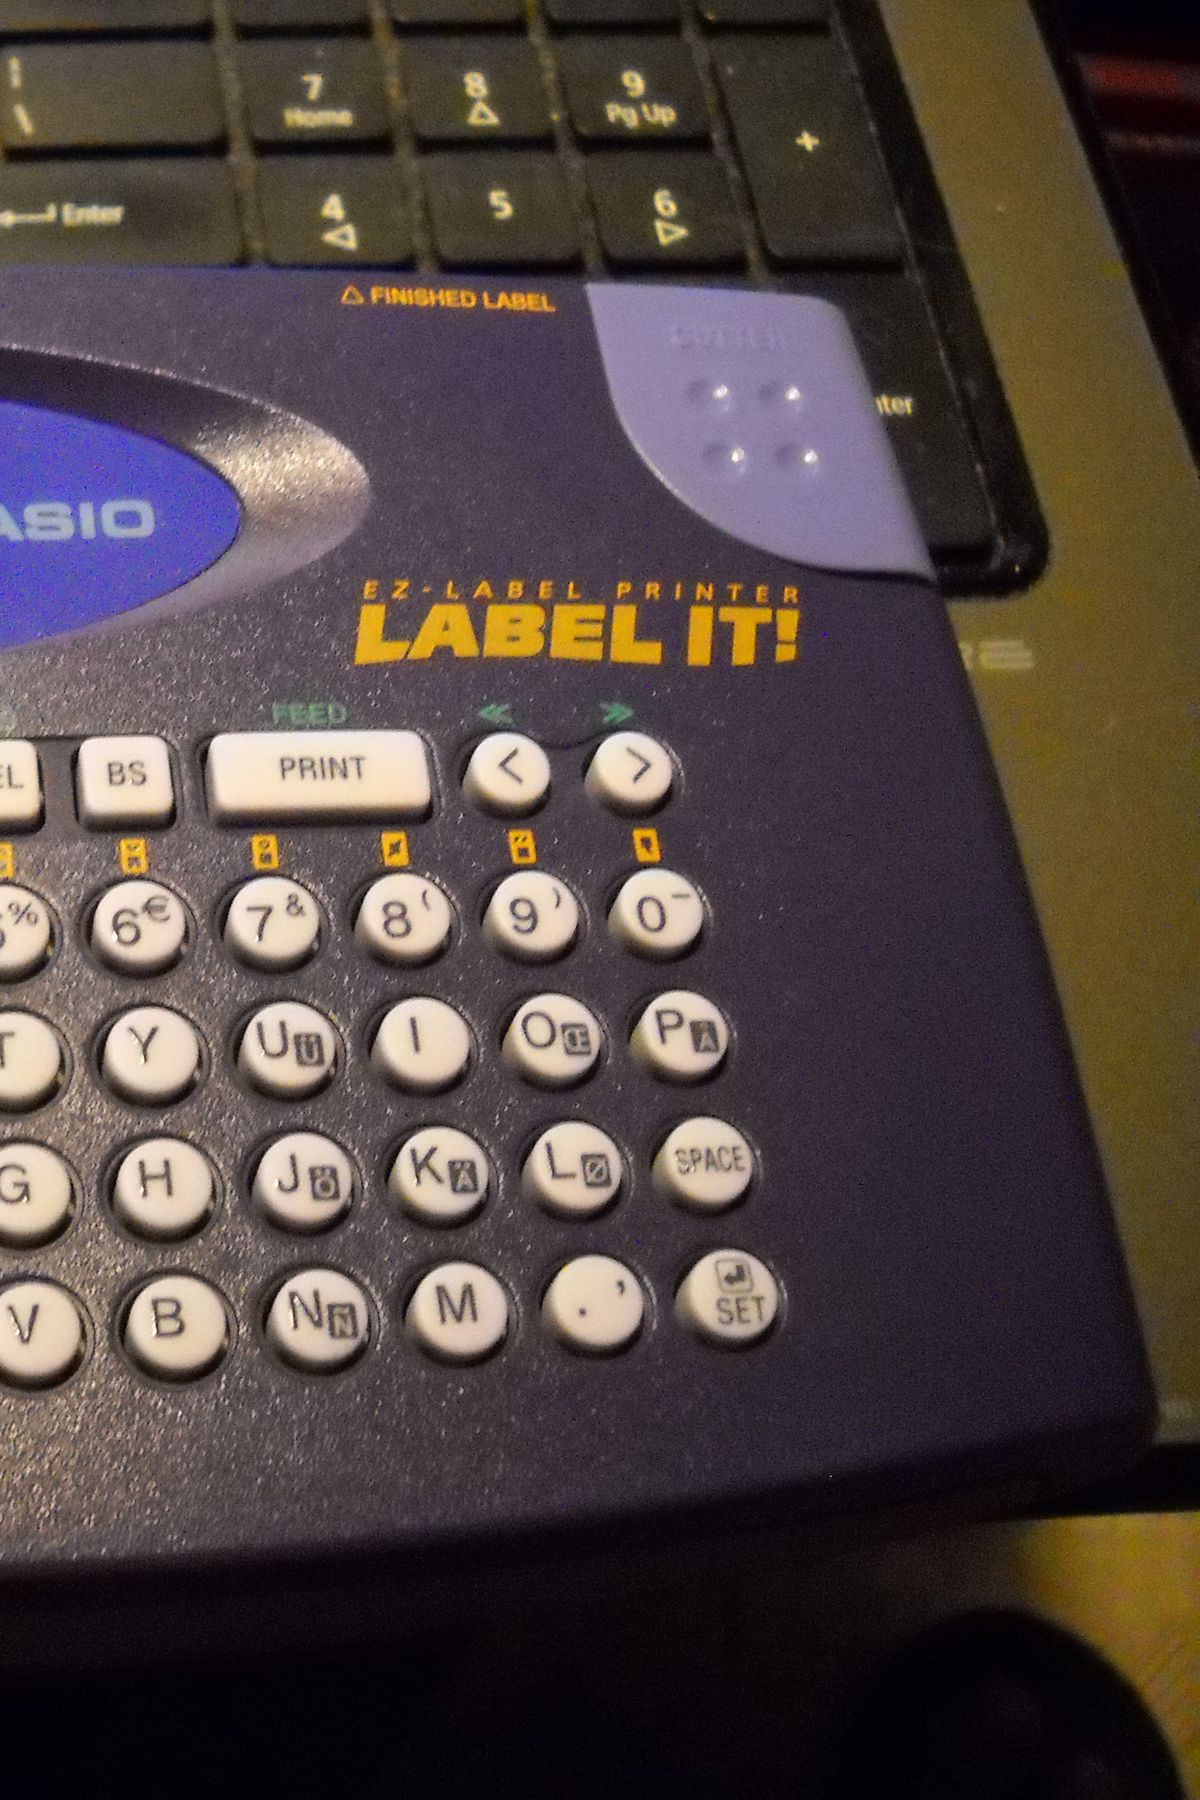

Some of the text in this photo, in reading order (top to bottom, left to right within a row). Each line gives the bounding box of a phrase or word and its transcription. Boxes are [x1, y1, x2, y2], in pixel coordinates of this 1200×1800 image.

[302, 73, 323, 101] 7
[463, 71, 488, 98] 8
[621, 70, 645, 98] 9
[606, 102, 677, 129] Pg Up
[62, 202, 124, 227] Enter
[321, 193, 346, 222] 4
[488, 189, 514, 220] 5
[653, 188, 677, 217] 6
[370, 286, 557, 312] FINISHED LABEL
[363, 580, 799, 604] EZ-LABEL PRINTER
[354, 603, 799, 667] LABEL IT!
[272, 701, 348, 724] FEED
[107, 761, 148, 787] BS
[279, 755, 366, 783] PRINT
[7, 902, 39, 928] %
[111, 894, 171, 947] 6 €
[247, 894, 307, 943] 7 &
[382, 900, 413, 939] 8
[509, 896, 540, 934] 9
[256, 1019, 289, 1060] U
[410, 1016, 422, 1054] I
[520, 1010, 557, 1050] O
[655, 1008, 685, 1044] P
[127, 1025, 160, 1066] Y
[138, 1158, 174, 1198] H
[275, 1153, 300, 1194] J
[410, 1145, 445, 1187] K
[545, 1141, 576, 1181] L
[674, 1143, 746, 1176] SPACE
[151, 1297, 186, 1339] B
[288, 1288, 322, 1331] N
[435, 1282, 478, 1326] M
[716, 1296, 767, 1326] SET
[7, 1303, 40, 1346] V
